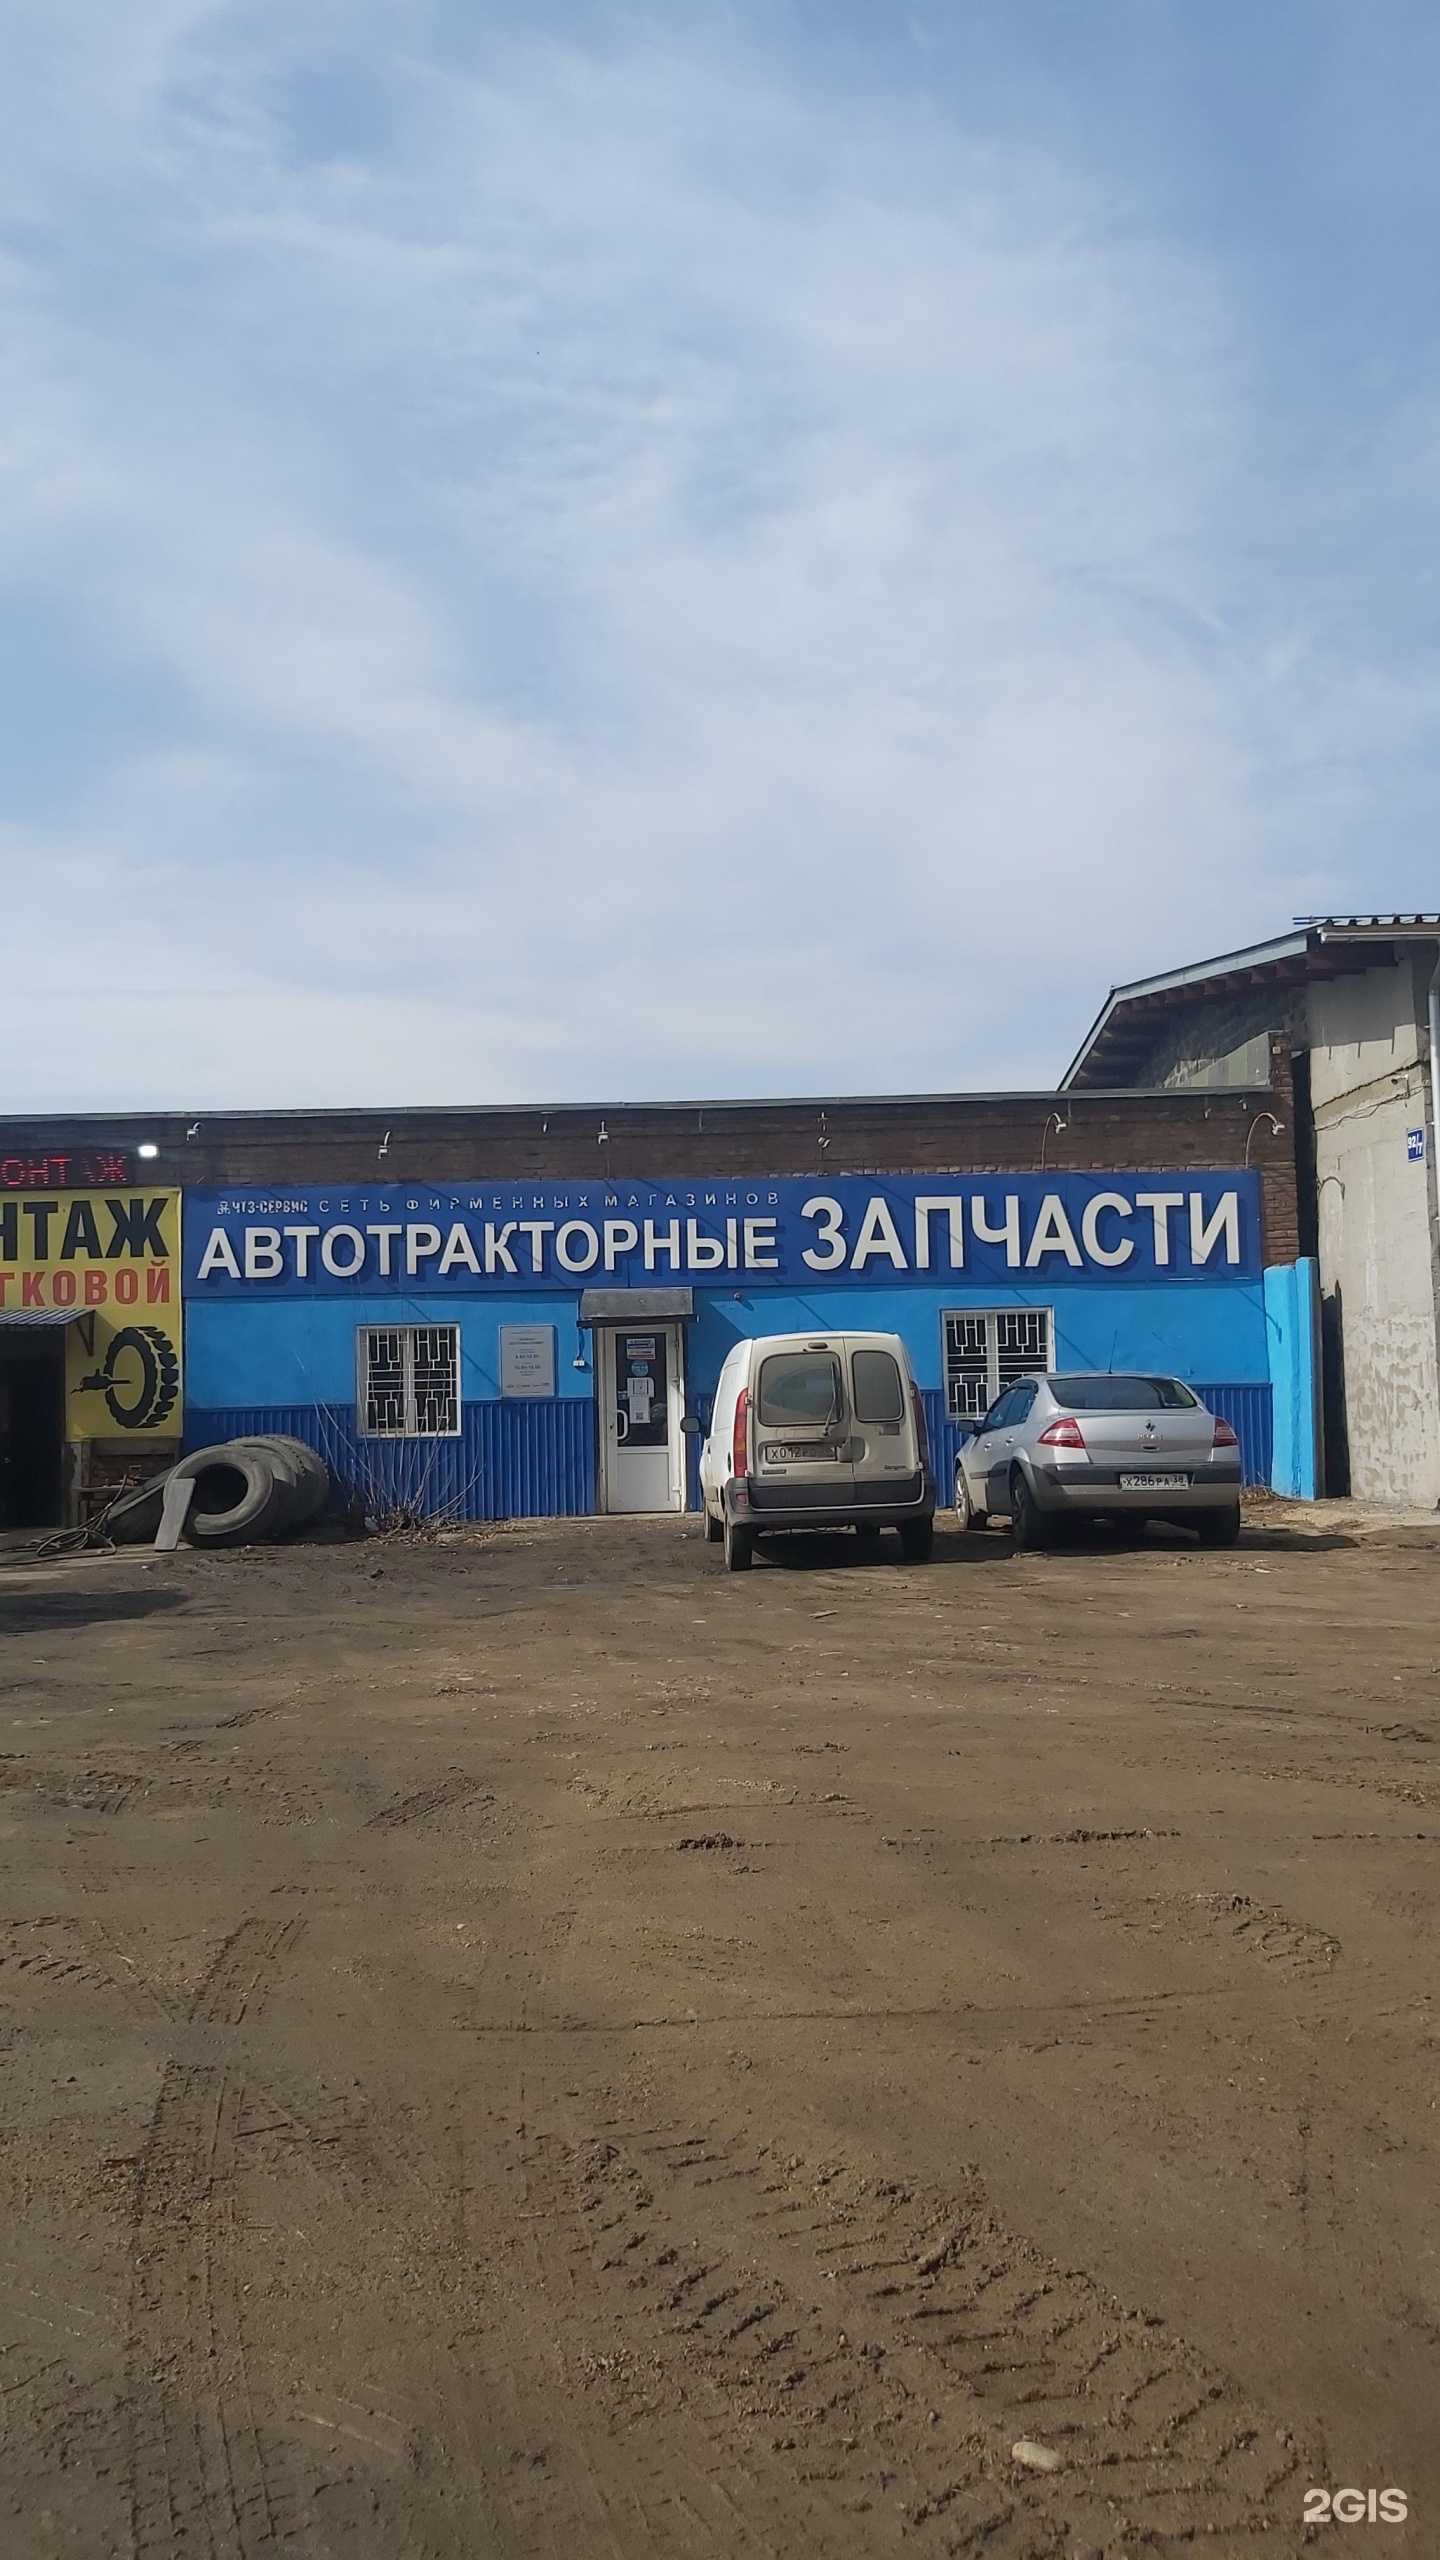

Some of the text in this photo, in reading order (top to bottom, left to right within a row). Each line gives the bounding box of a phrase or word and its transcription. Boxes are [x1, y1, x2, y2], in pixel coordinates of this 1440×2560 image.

[319, 1199, 391, 1213] СЕТЬ
[604, 1191, 780, 1208] МАГАЗИНОВ
[198, 1191, 1240, 1280] АВТОТРАКТОРНЫЕ ЗАПЧАСТИ
